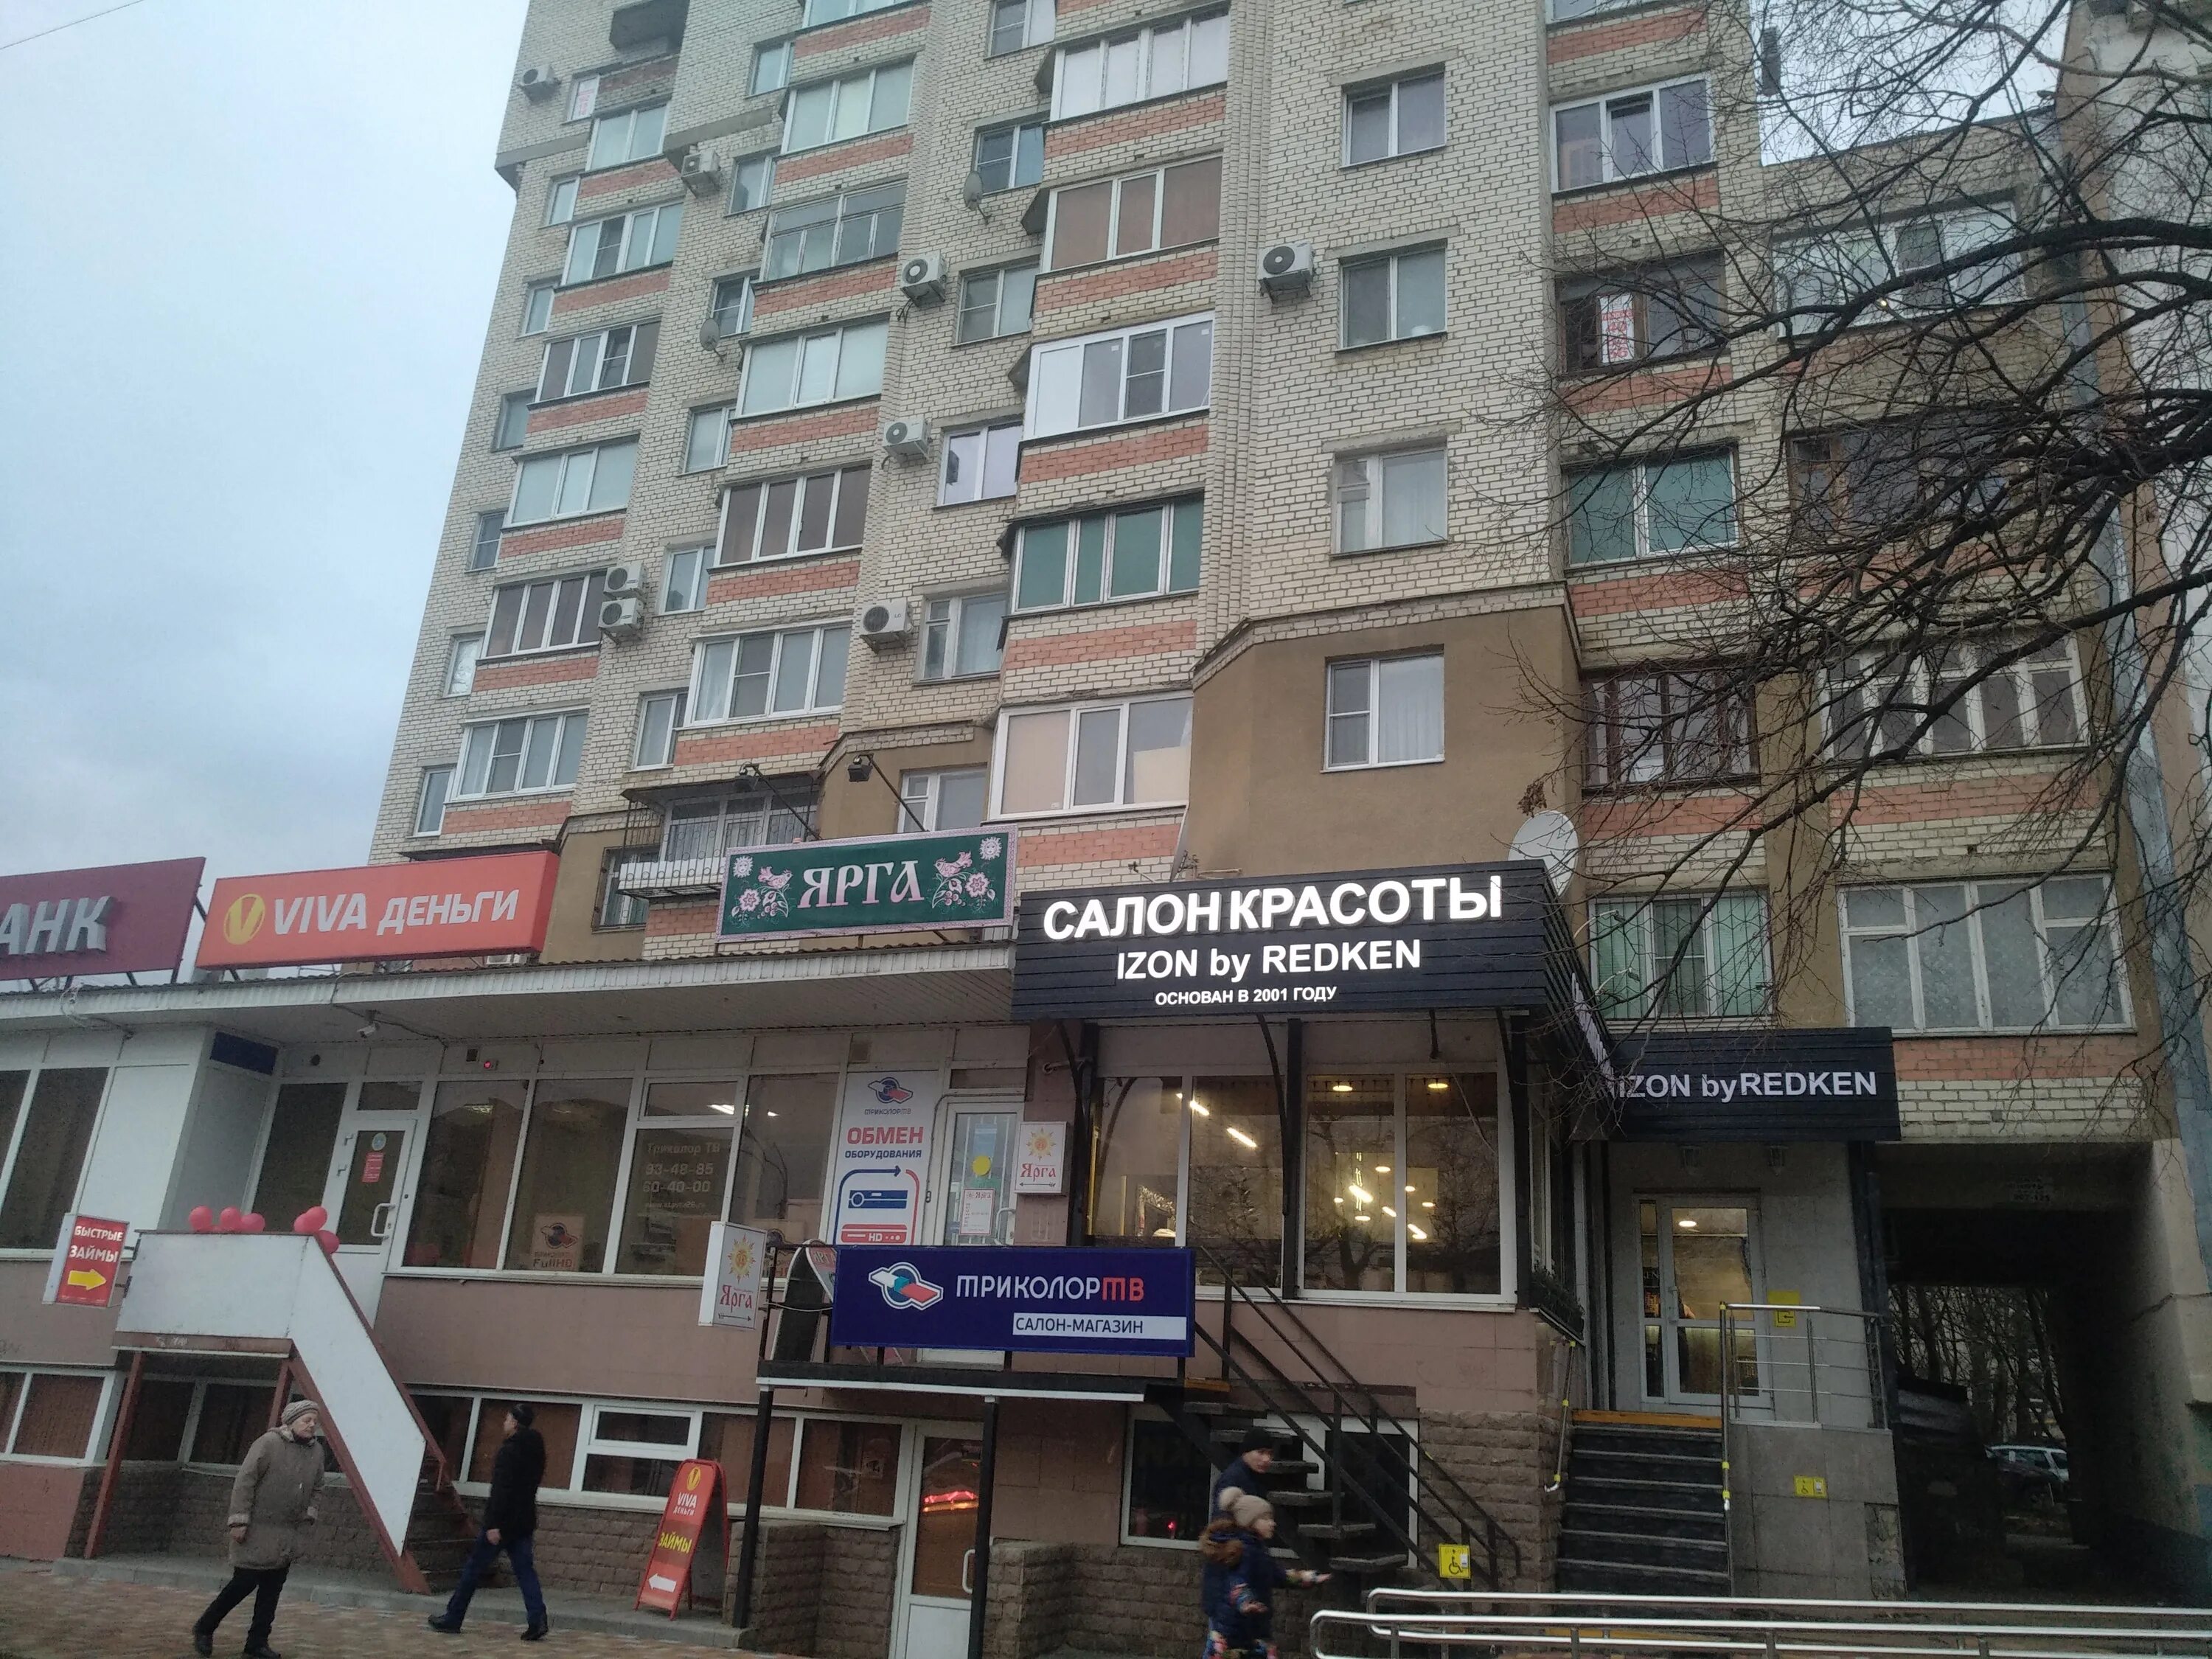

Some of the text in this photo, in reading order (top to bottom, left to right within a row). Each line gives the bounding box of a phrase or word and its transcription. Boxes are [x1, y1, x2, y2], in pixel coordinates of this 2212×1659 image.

[798, 860, 924, 909] ЯРГА
[274, 892, 367, 935] VIVA
[376, 889, 519, 936] ДЕНЬГИ
[1043, 875, 1502, 941] САЛОН КРАСОТЫ
[1117, 939, 1422, 983] IZON by REDKEN
[1155, 987, 1338, 1006] ОСНОВАН В 2001 ГОДУ
[1702, 1074, 1737, 1103] by
[1740, 1071, 1877, 1096] REDKEN
[846, 1127, 924, 1144] ОБМЕН
[845, 1150, 922, 1159] ОБОРУДОВАНИЯ
[1020, 1163, 1056, 1182] Ярга
[74, 1225, 124, 1241] БЫСТРЫЕ
[868, 1233, 883, 1242] HD
[69, 1245, 119, 1262] ЗАЙМЫ
[720, 1284, 752, 1312] Ярга
[1015, 1317, 1144, 1334] САЛОН-МАГАЗИН
[677, 1492, 698, 1509] VIVA
[673, 1506, 695, 1516] ДЕНЬГИ
[658, 1531, 693, 1554] ЗАЙМЫ
